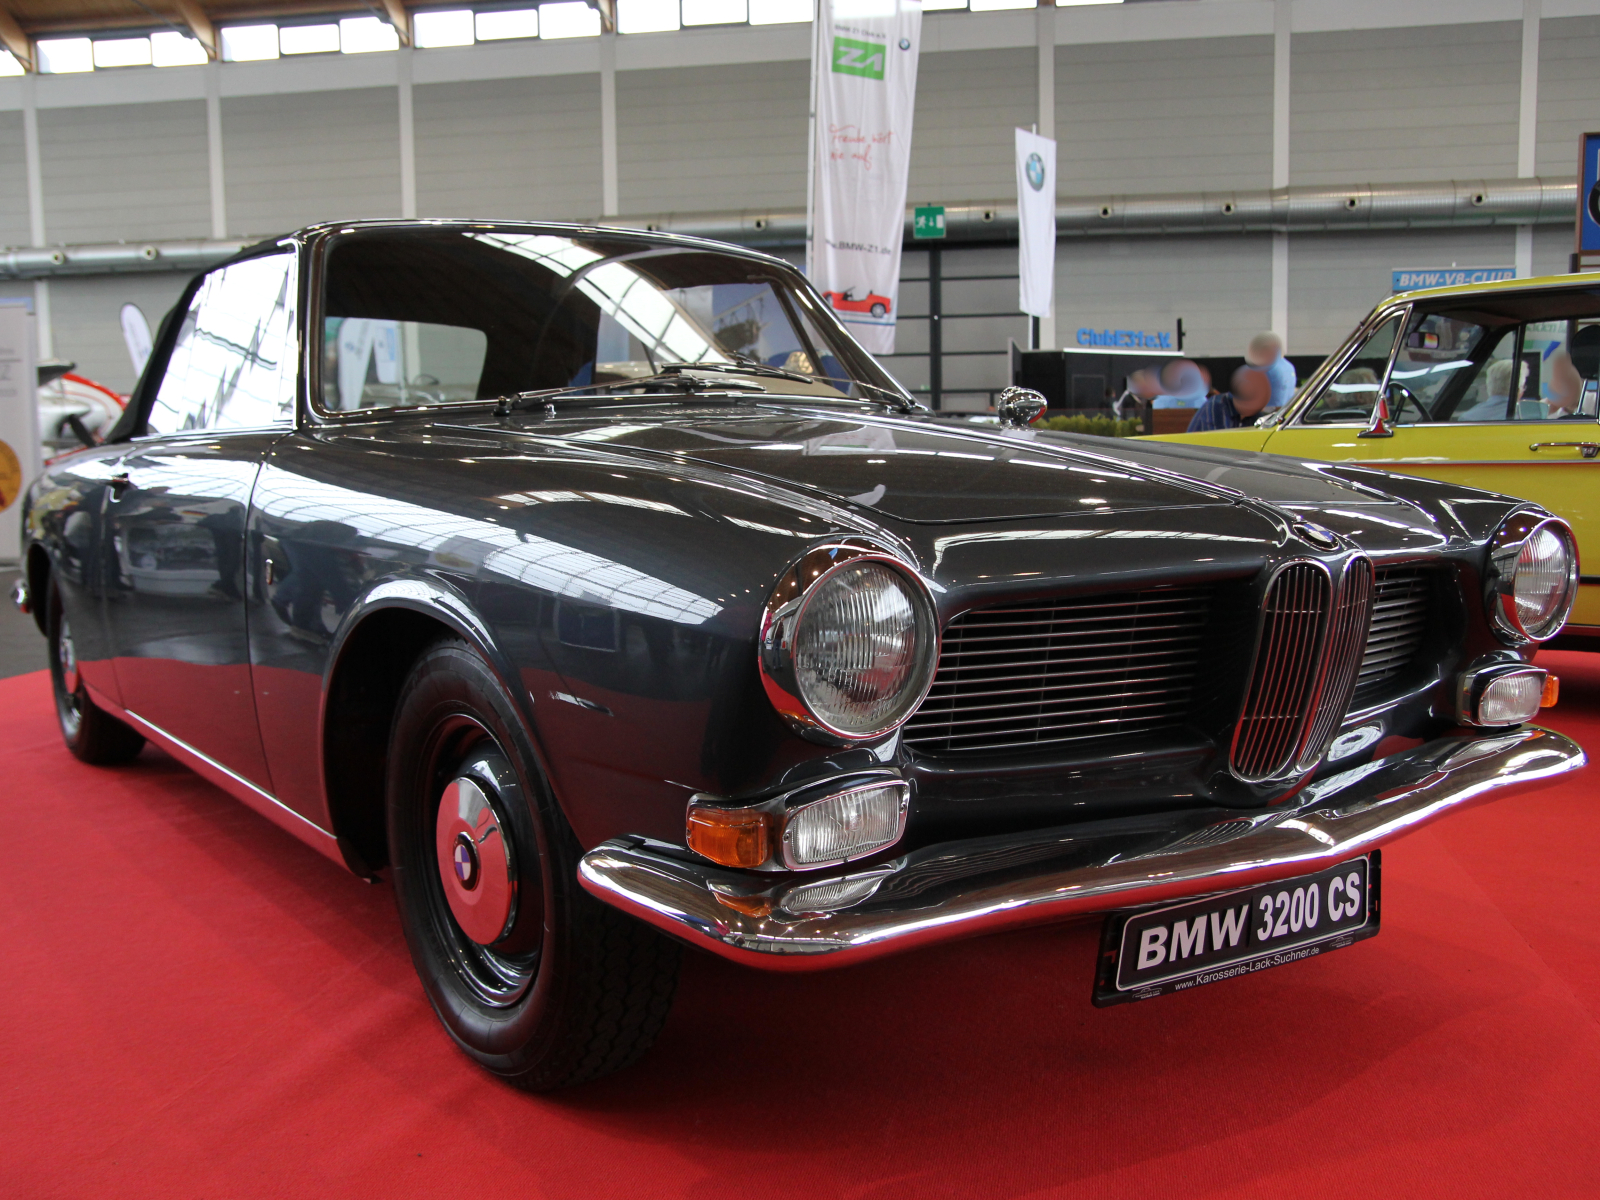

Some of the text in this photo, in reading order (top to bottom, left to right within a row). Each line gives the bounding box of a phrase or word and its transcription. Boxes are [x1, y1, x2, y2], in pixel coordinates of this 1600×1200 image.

[1136, 871, 1361, 971] BMW 3200 CS
[1174, 945, 1320, 991] www.Karosserie-Lack-Suchner.de
